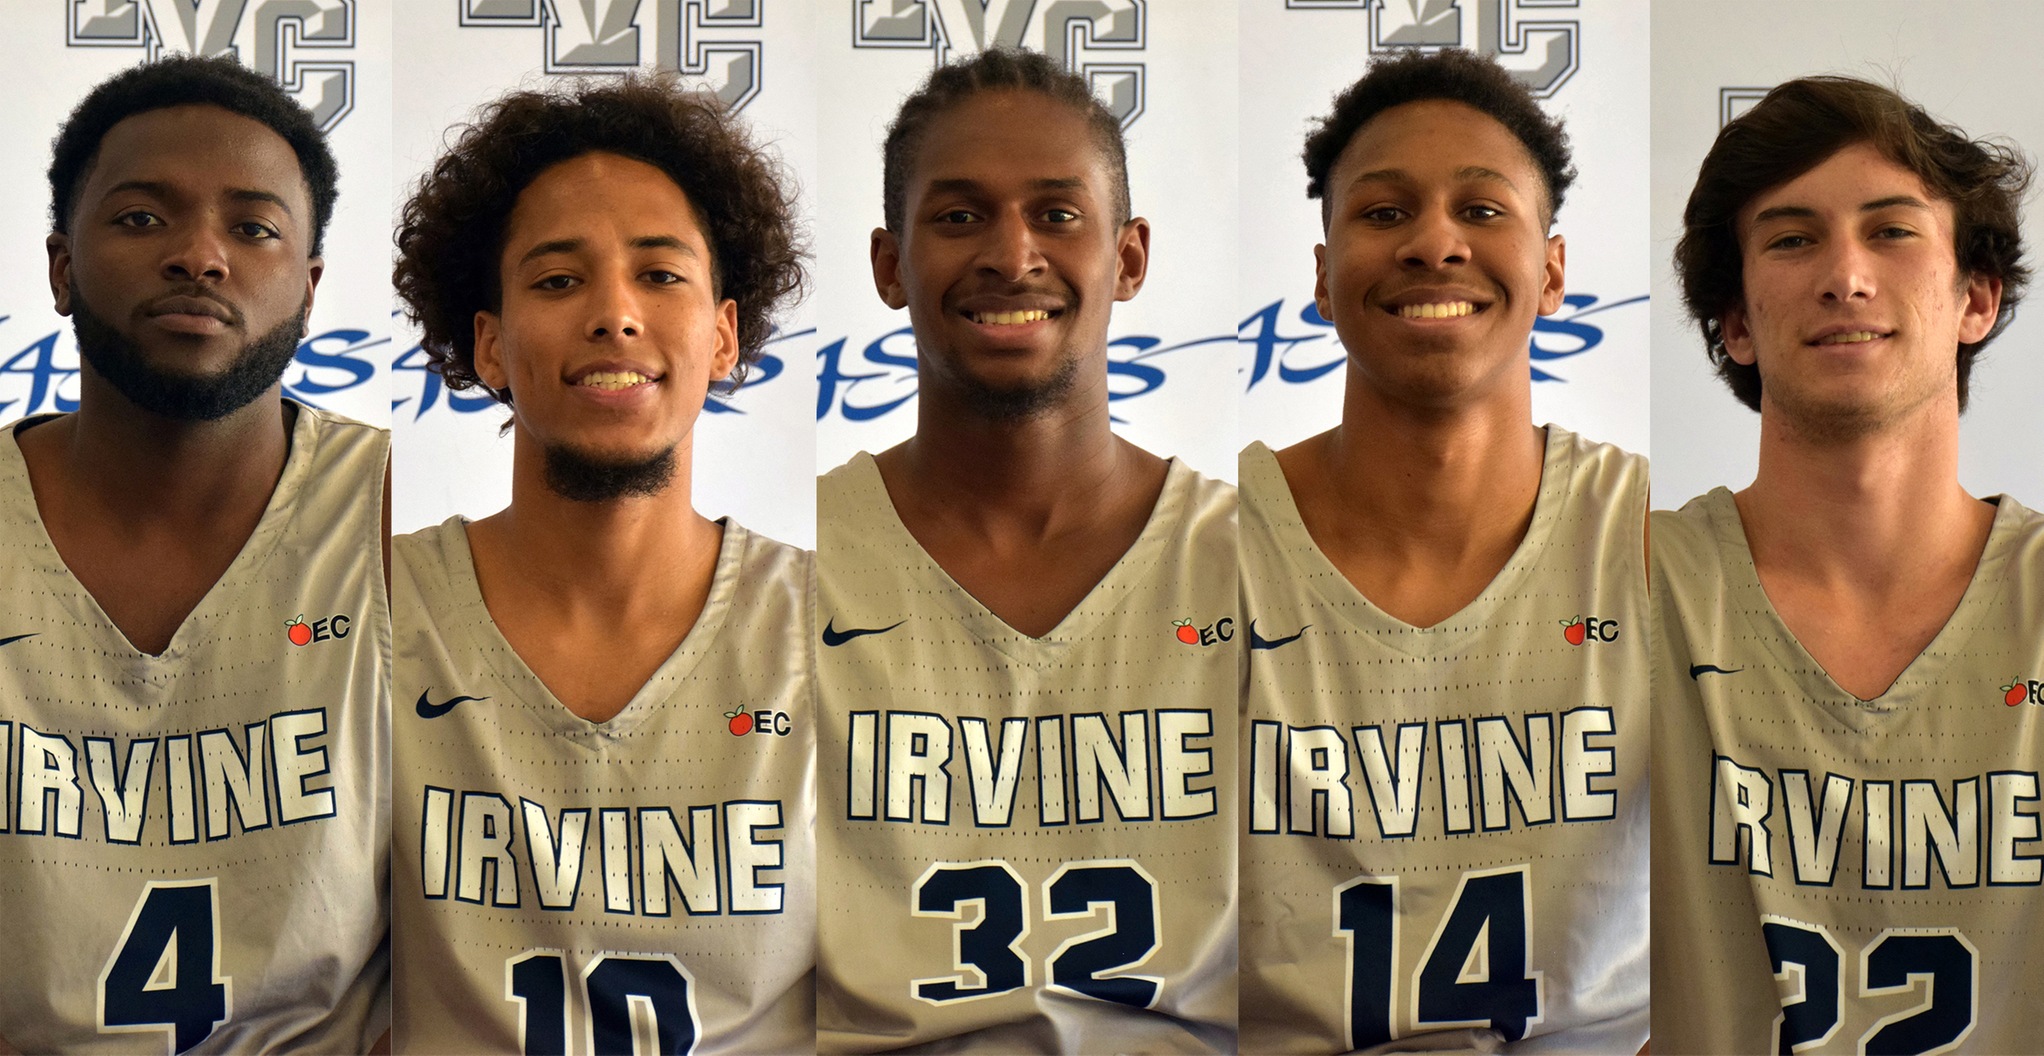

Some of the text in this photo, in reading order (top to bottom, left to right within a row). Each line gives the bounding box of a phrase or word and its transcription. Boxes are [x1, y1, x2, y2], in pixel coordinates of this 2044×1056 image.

[312, 614, 351, 643] EC
[1199, 617, 1235, 647] EC
[1585, 616, 1620, 642] EC
[754, 710, 791, 736] EC
[846, 708, 1218, 828] IRVINE
[1249, 706, 1618, 840] IRVINE
[422, 785, 785, 917] IRVINE
[97, 877, 232, 1056] 4
[910, 858, 1165, 1008] 32
[1332, 864, 1545, 1052] 14
[504, 948, 702, 1056] 10
